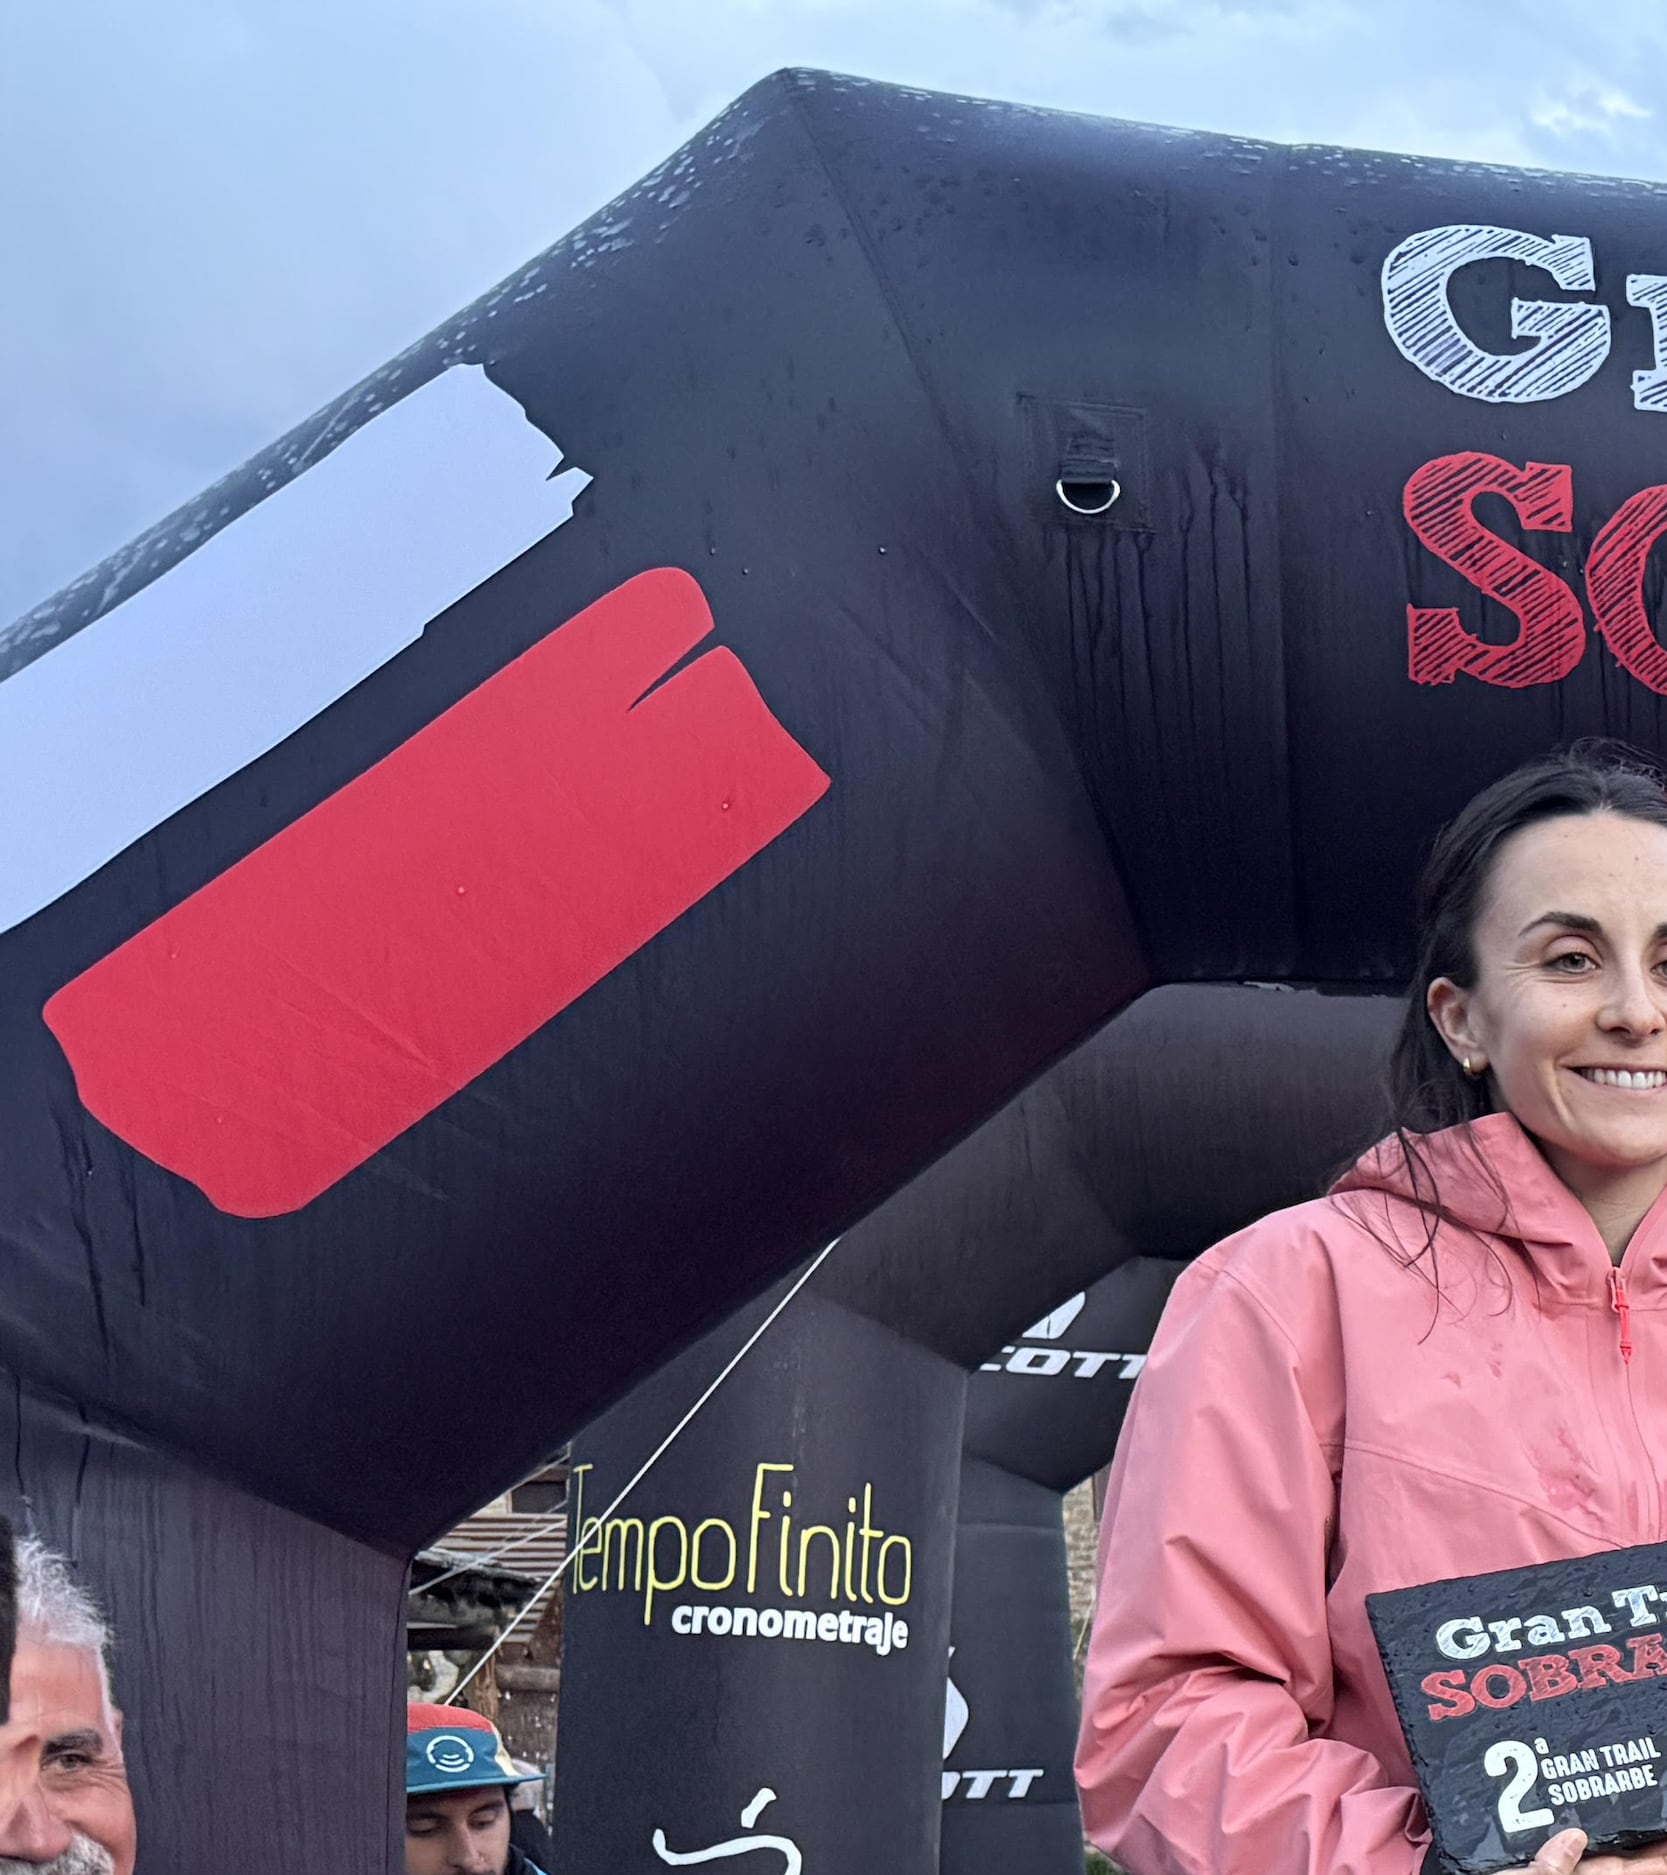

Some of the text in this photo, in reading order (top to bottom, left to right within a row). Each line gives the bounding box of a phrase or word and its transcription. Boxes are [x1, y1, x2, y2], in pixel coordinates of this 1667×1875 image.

[671, 1604, 909, 1656] cronometraje
[1435, 1604, 1612, 1661] Gran
[1540, 1737, 1661, 1780] GRAN TRAIL
[1548, 1764, 1658, 1806] SOBRARBE
